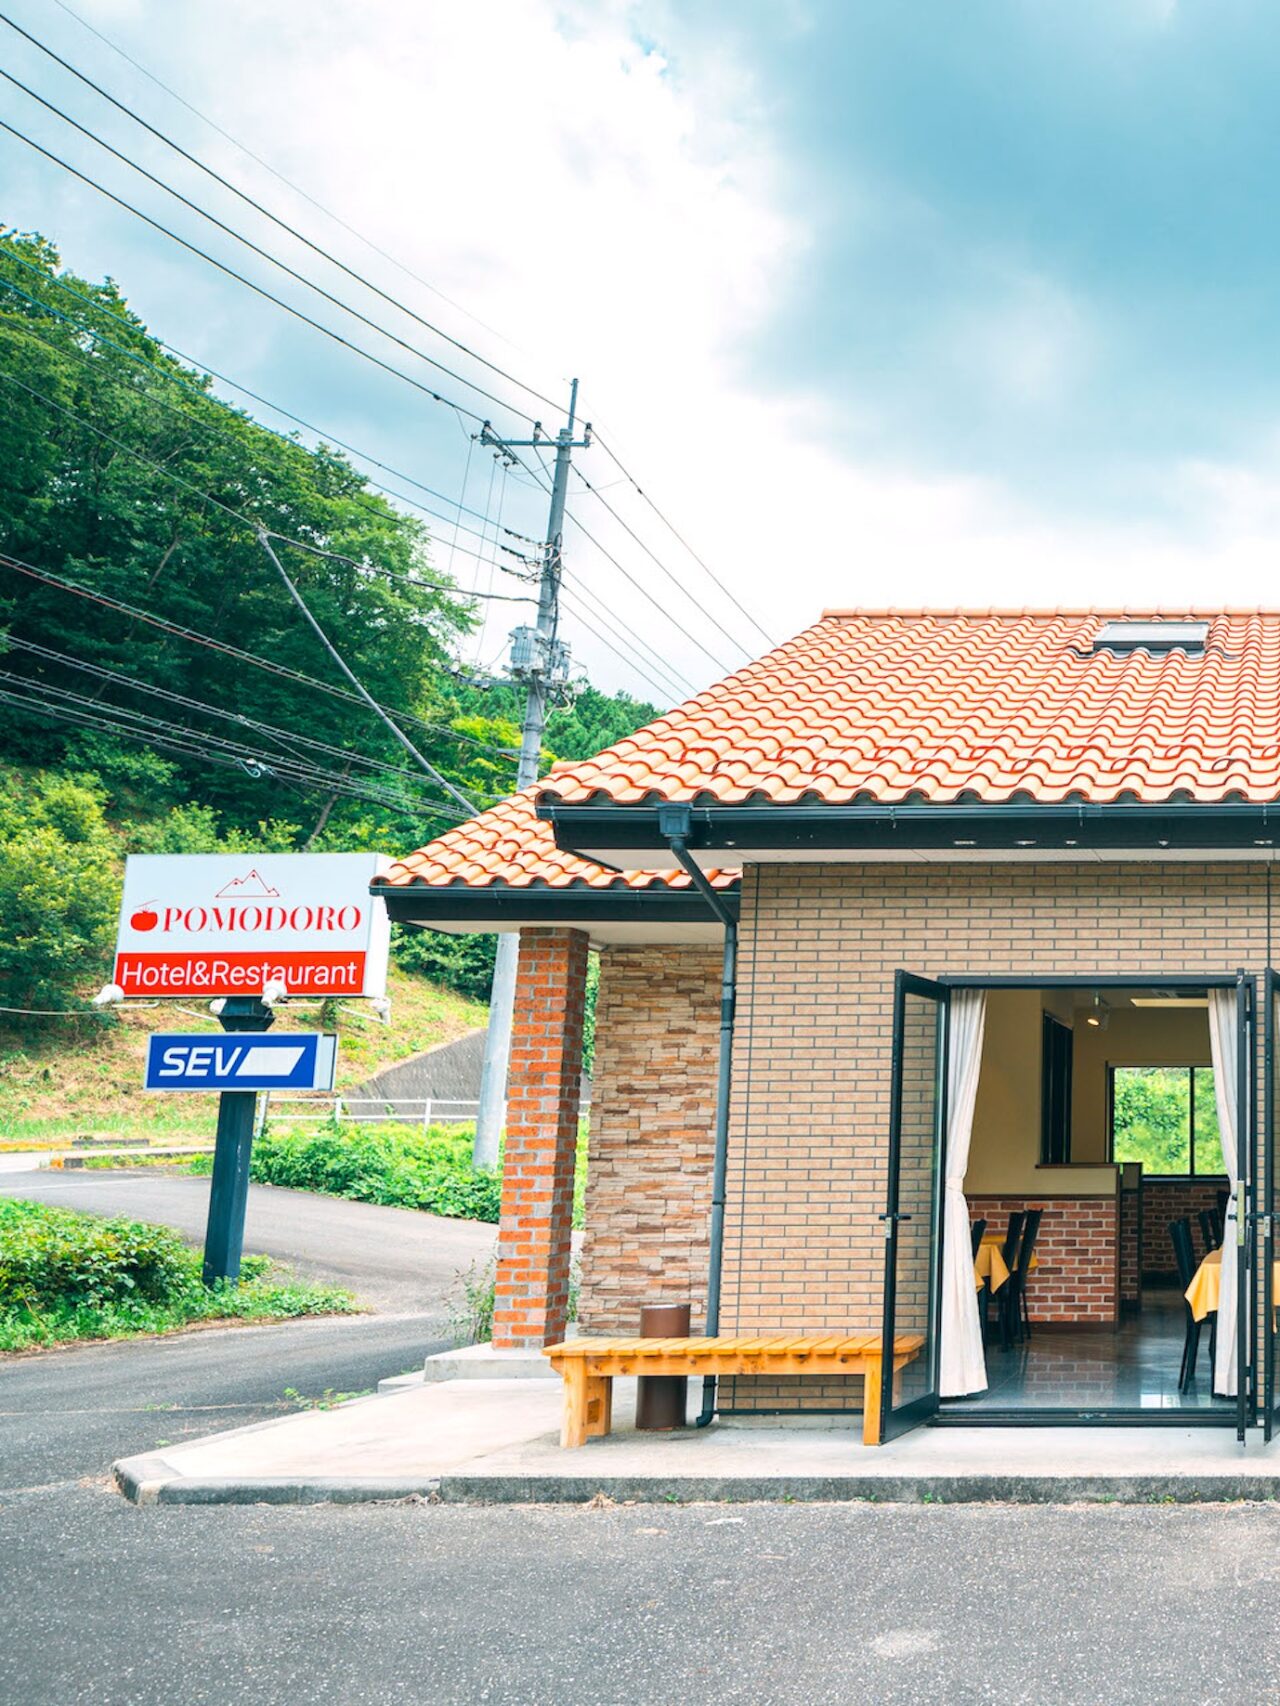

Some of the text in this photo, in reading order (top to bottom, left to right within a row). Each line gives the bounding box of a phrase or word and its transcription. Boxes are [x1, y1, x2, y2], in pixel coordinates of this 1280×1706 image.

[163, 906, 361, 931] POMODORO
[121, 961, 357, 986] Hotel&Restaurant
[159, 1047, 242, 1076] SEV
